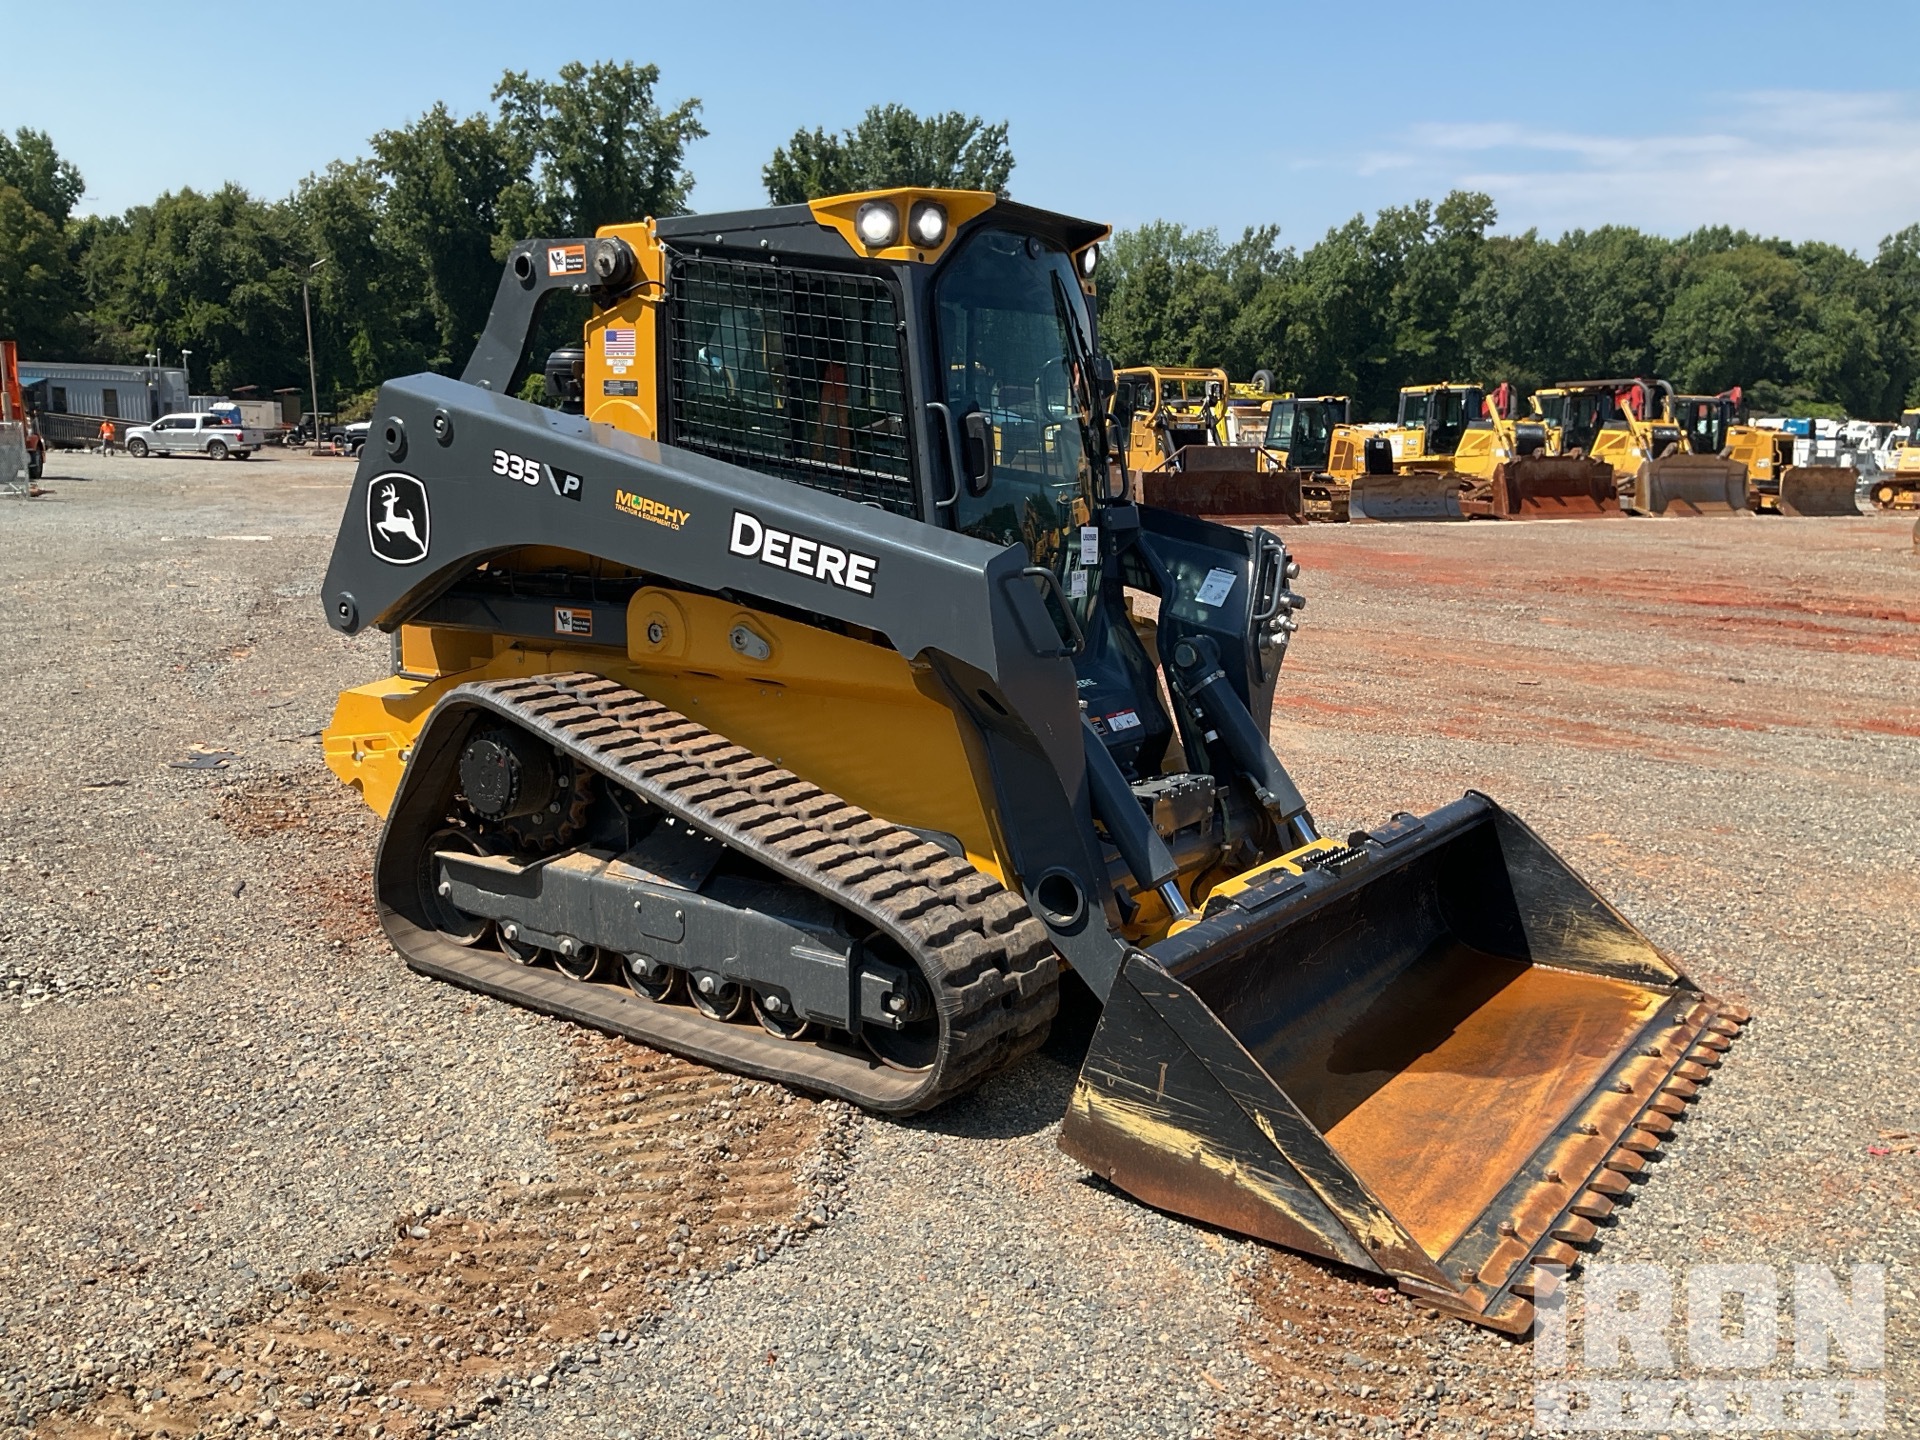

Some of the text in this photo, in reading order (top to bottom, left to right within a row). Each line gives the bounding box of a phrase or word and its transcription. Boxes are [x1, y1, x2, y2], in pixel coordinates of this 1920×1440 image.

[492, 449, 540, 486] 335
[615, 489, 691, 526] MURPHY
[615, 503, 638, 516] TRACTOR
[642, 512, 671, 528] EQUIPMENT
[729, 511, 877, 594] DEERE
